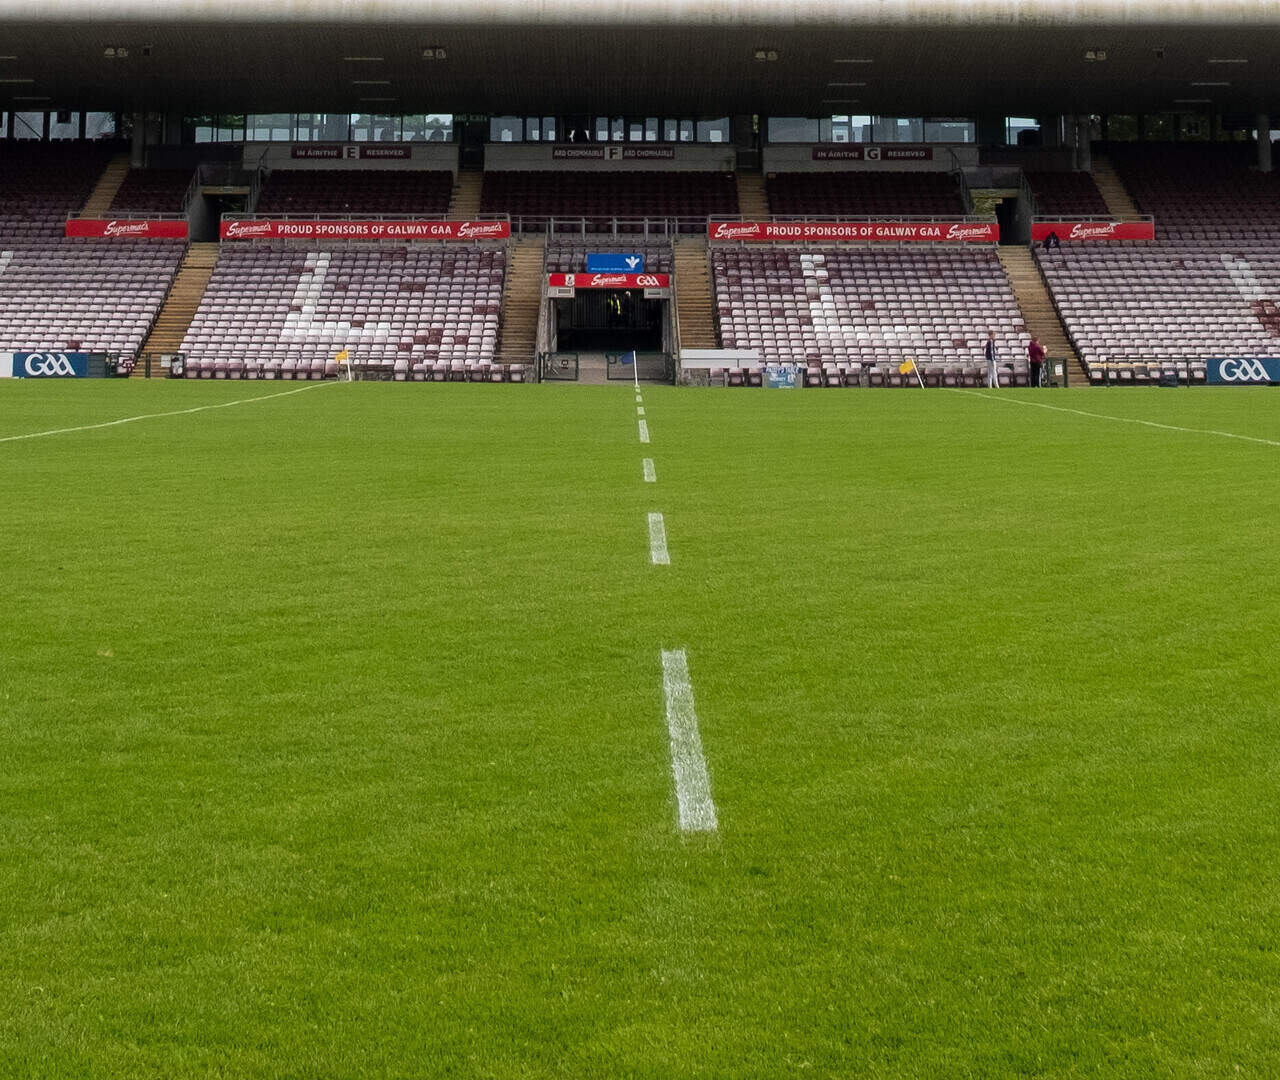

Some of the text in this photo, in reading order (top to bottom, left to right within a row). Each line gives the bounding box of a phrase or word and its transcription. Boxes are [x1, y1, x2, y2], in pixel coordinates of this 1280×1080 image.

[347, 147, 356, 158] E
[610, 147, 618, 159] F
[867, 148, 878, 160] G
[226, 222, 502, 237] Supermac's PROUD SPONSORS OF GALWAY GAA Supermac's
[715, 223, 992, 239] Supermac's PROUD SPONSORS OF GALWAY GAA Supermac's
[636, 275, 659, 286] GAA
[280, 252, 390, 337] L
[24, 353, 76, 375] GAA
[1218, 359, 1271, 381] GAA
